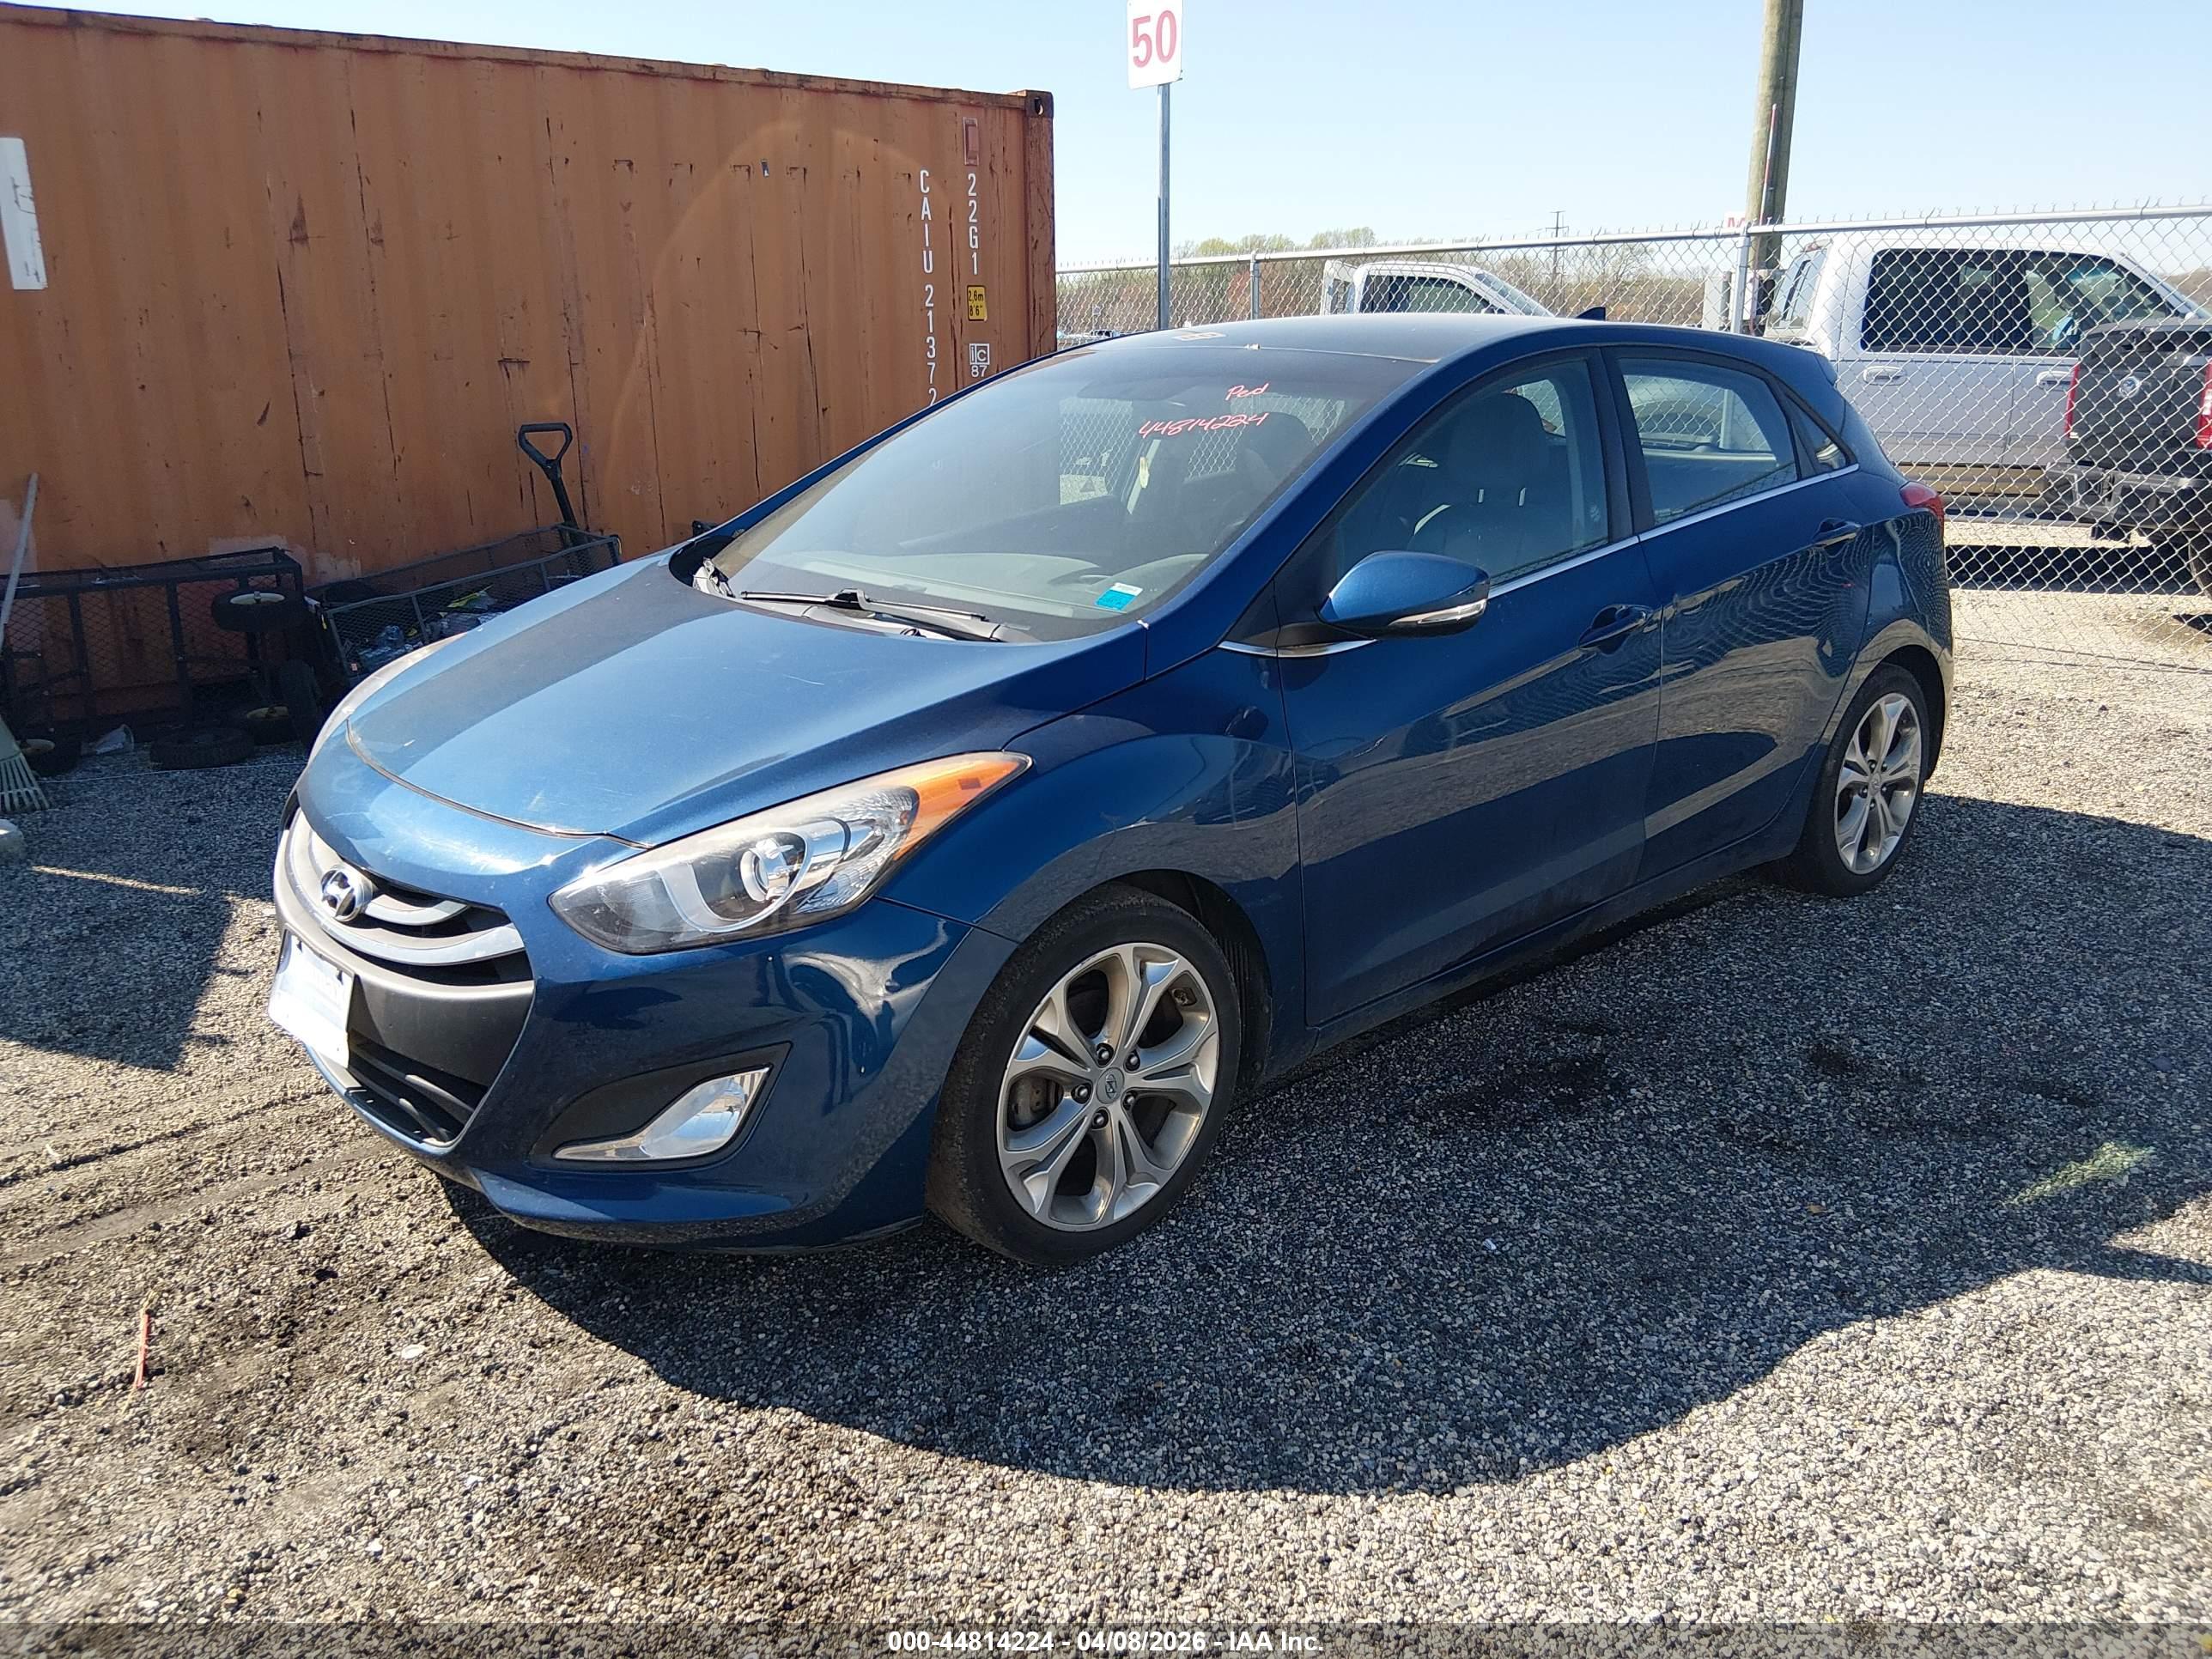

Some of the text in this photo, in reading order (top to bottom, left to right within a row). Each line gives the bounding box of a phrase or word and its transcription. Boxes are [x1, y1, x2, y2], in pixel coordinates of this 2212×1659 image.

[1133, 9, 1177, 68] 50
[920, 169, 933, 274] CAIU
[967, 173, 979, 276] 22G1
[971, 365, 988, 378] 87
[1138, 412, 1270, 439] 44814224
